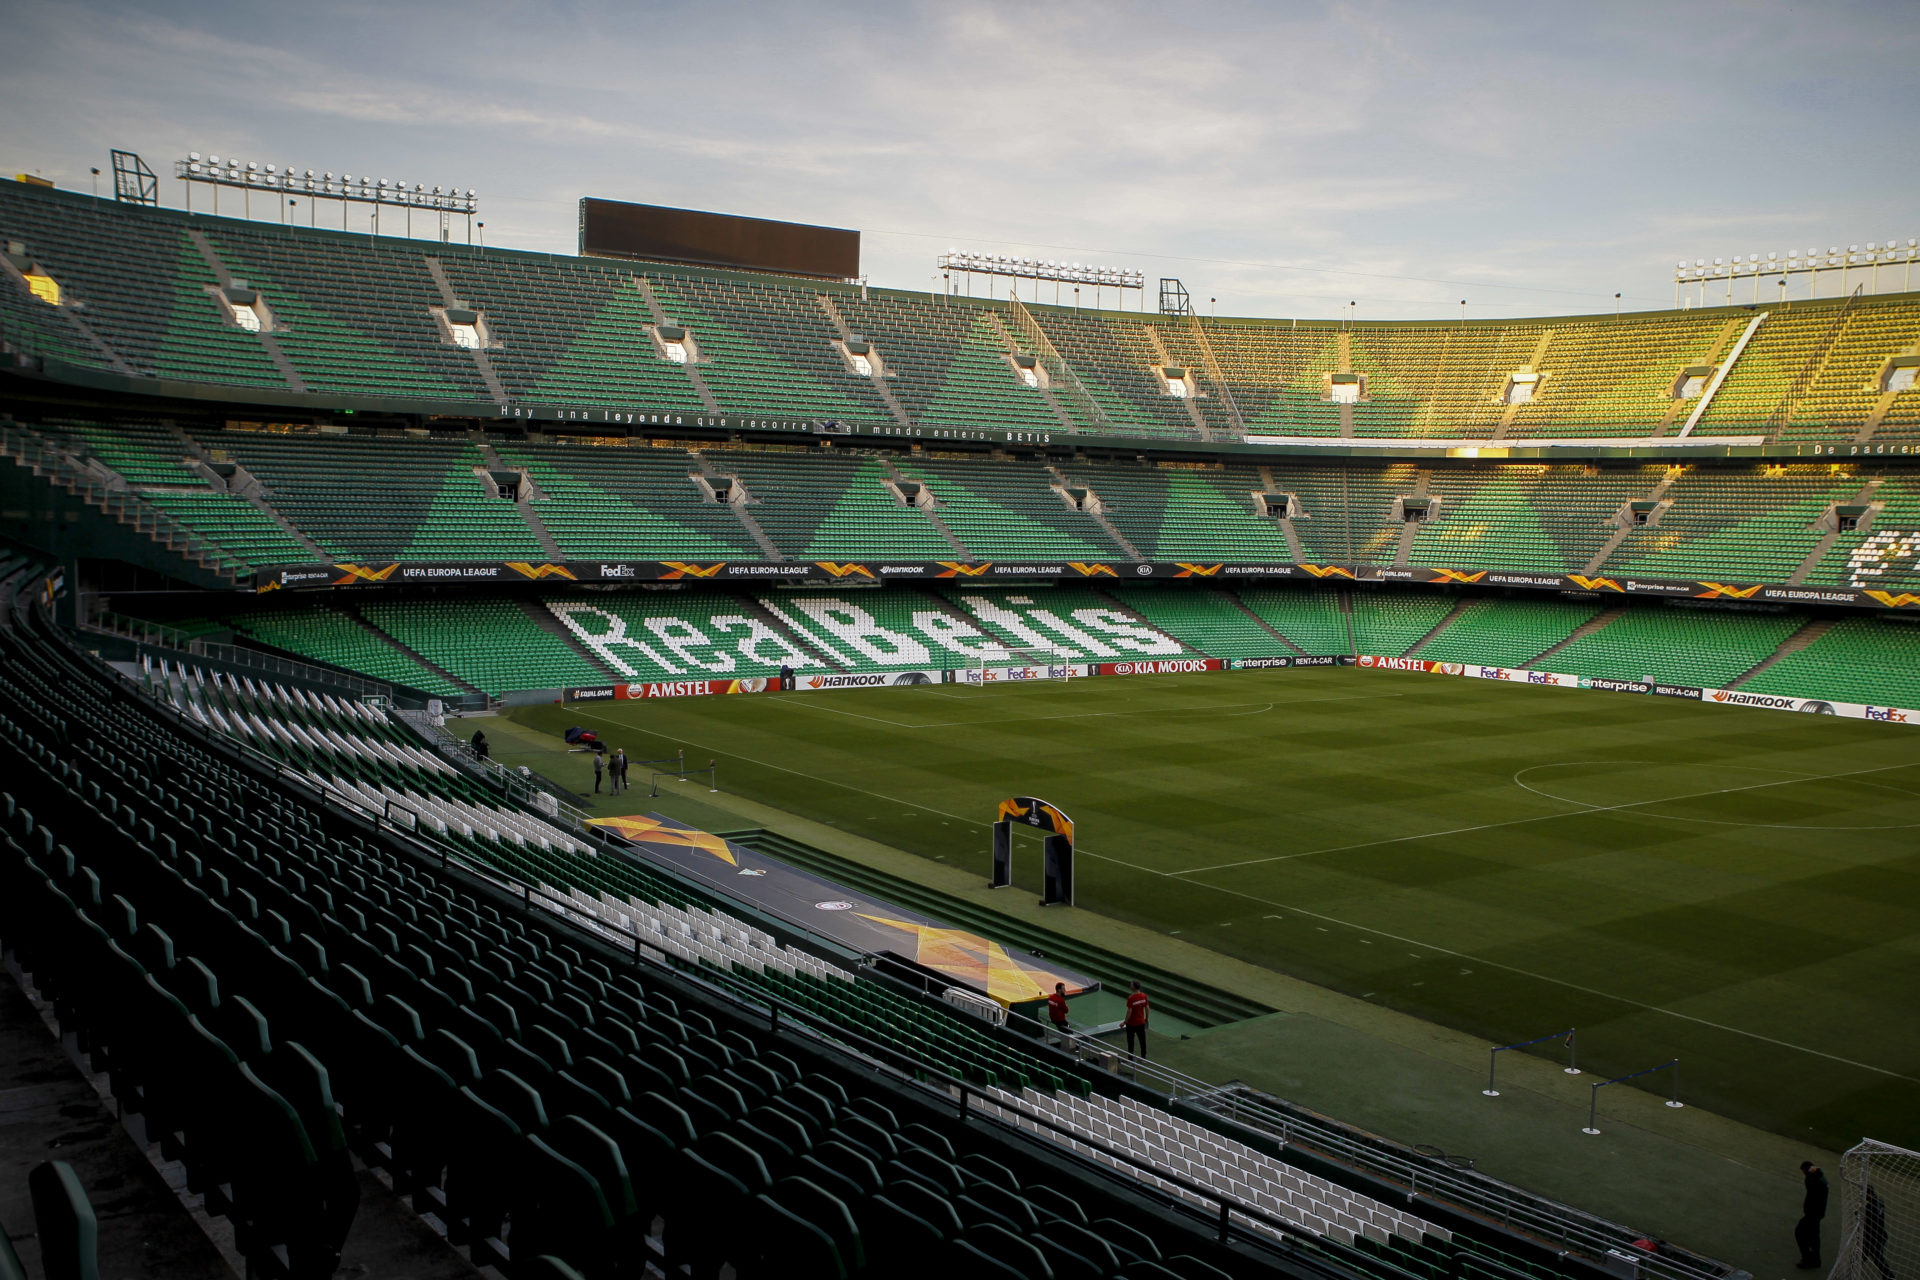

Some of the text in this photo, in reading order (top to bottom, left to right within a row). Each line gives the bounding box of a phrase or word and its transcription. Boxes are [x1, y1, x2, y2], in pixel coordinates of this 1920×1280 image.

[501, 406, 1050, 443] Hay una leyenda que recorre el mundo entero, BETIS
[1814, 444, 1835, 455] De
[403, 567, 498, 577] UEFA EUROPA LEAGUE
[600, 564, 635, 577] FedEx
[729, 566, 809, 575] UEFA EUROPA LEAGUE
[994, 566, 1063, 574] UEFA EUROPA LEAGUE
[1489, 575, 1561, 585] UEFA EUROPA LEAGUE
[1765, 589, 1855, 601] UEFA EUROPA LEAGUE
[546, 595, 1184, 677] Real Betis
[1134, 660, 1207, 674] KIA MOTORS
[1233, 657, 1287, 669] enterprise
[1295, 656, 1333, 666] RENT-A-CAR
[1377, 656, 1427, 672] AMSTEL
[1007, 667, 1038, 680] FedEx
[1480, 666, 1511, 681] FedEx
[1528, 671, 1559, 685] FedEx
[648, 681, 713, 698] AMSTEL
[1581, 677, 1700, 698] enterprise RENT-A-CAR
[1865, 706, 1908, 722] FedEx
